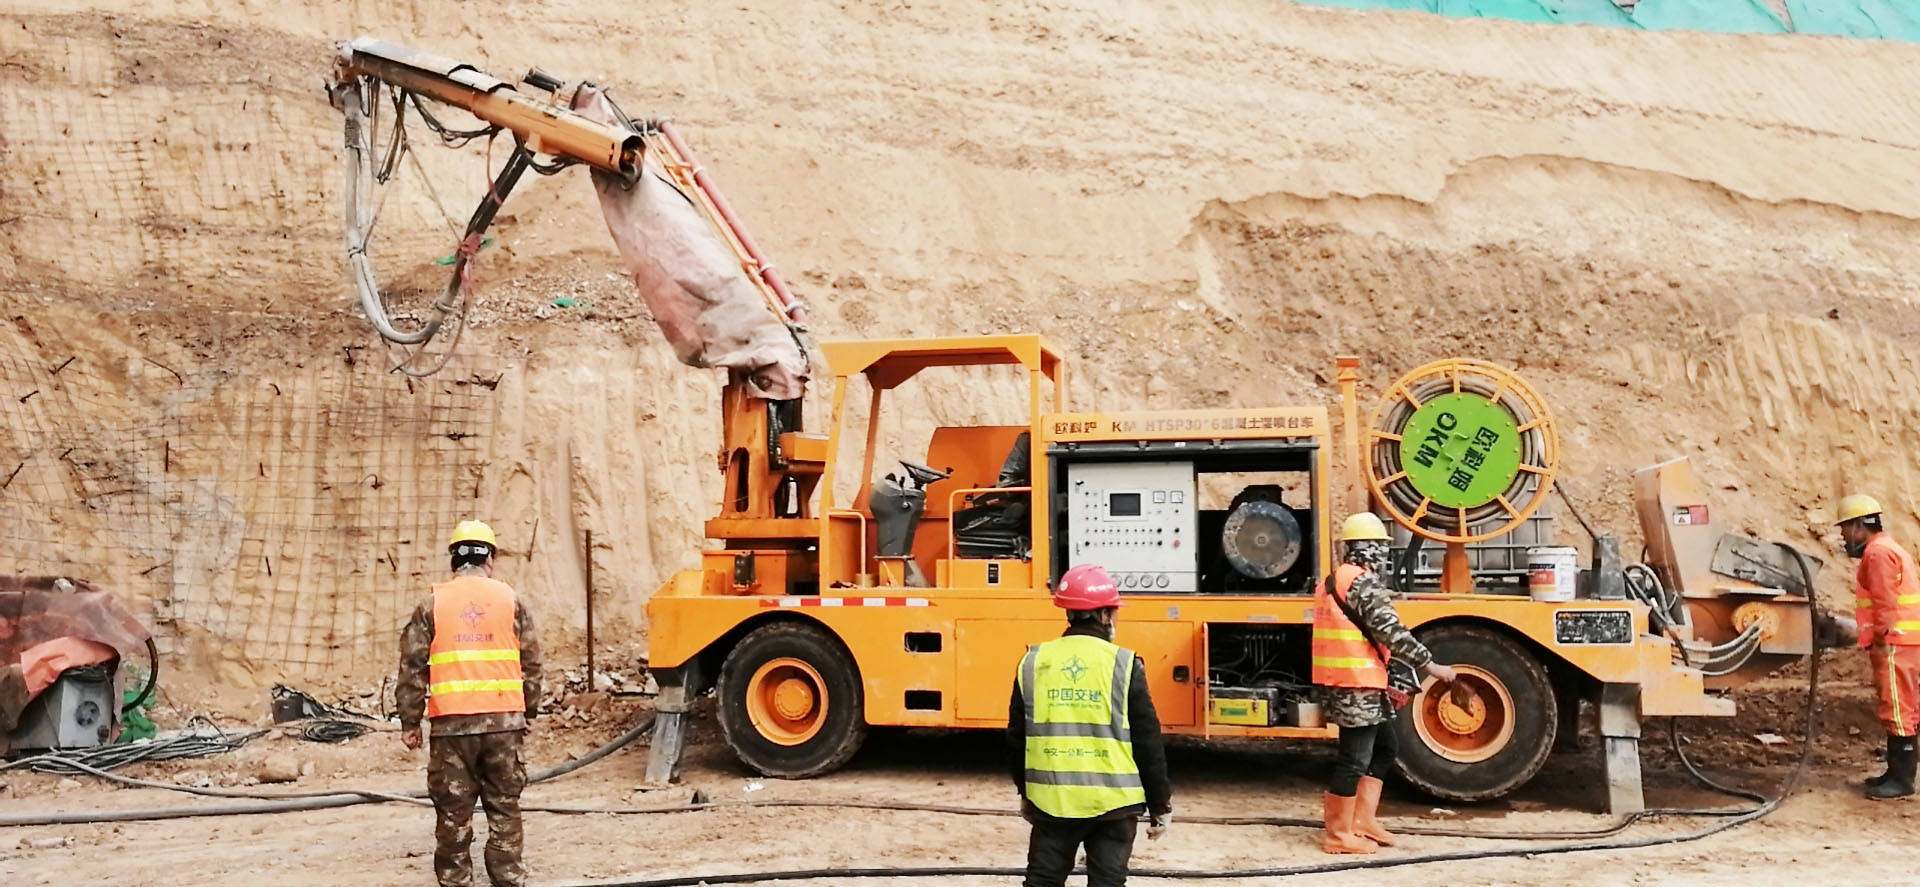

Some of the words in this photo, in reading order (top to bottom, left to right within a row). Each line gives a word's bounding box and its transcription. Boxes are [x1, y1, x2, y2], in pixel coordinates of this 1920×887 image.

[1413, 412, 1457, 468] OKM
[1047, 687, 1102, 702] 中国交建
